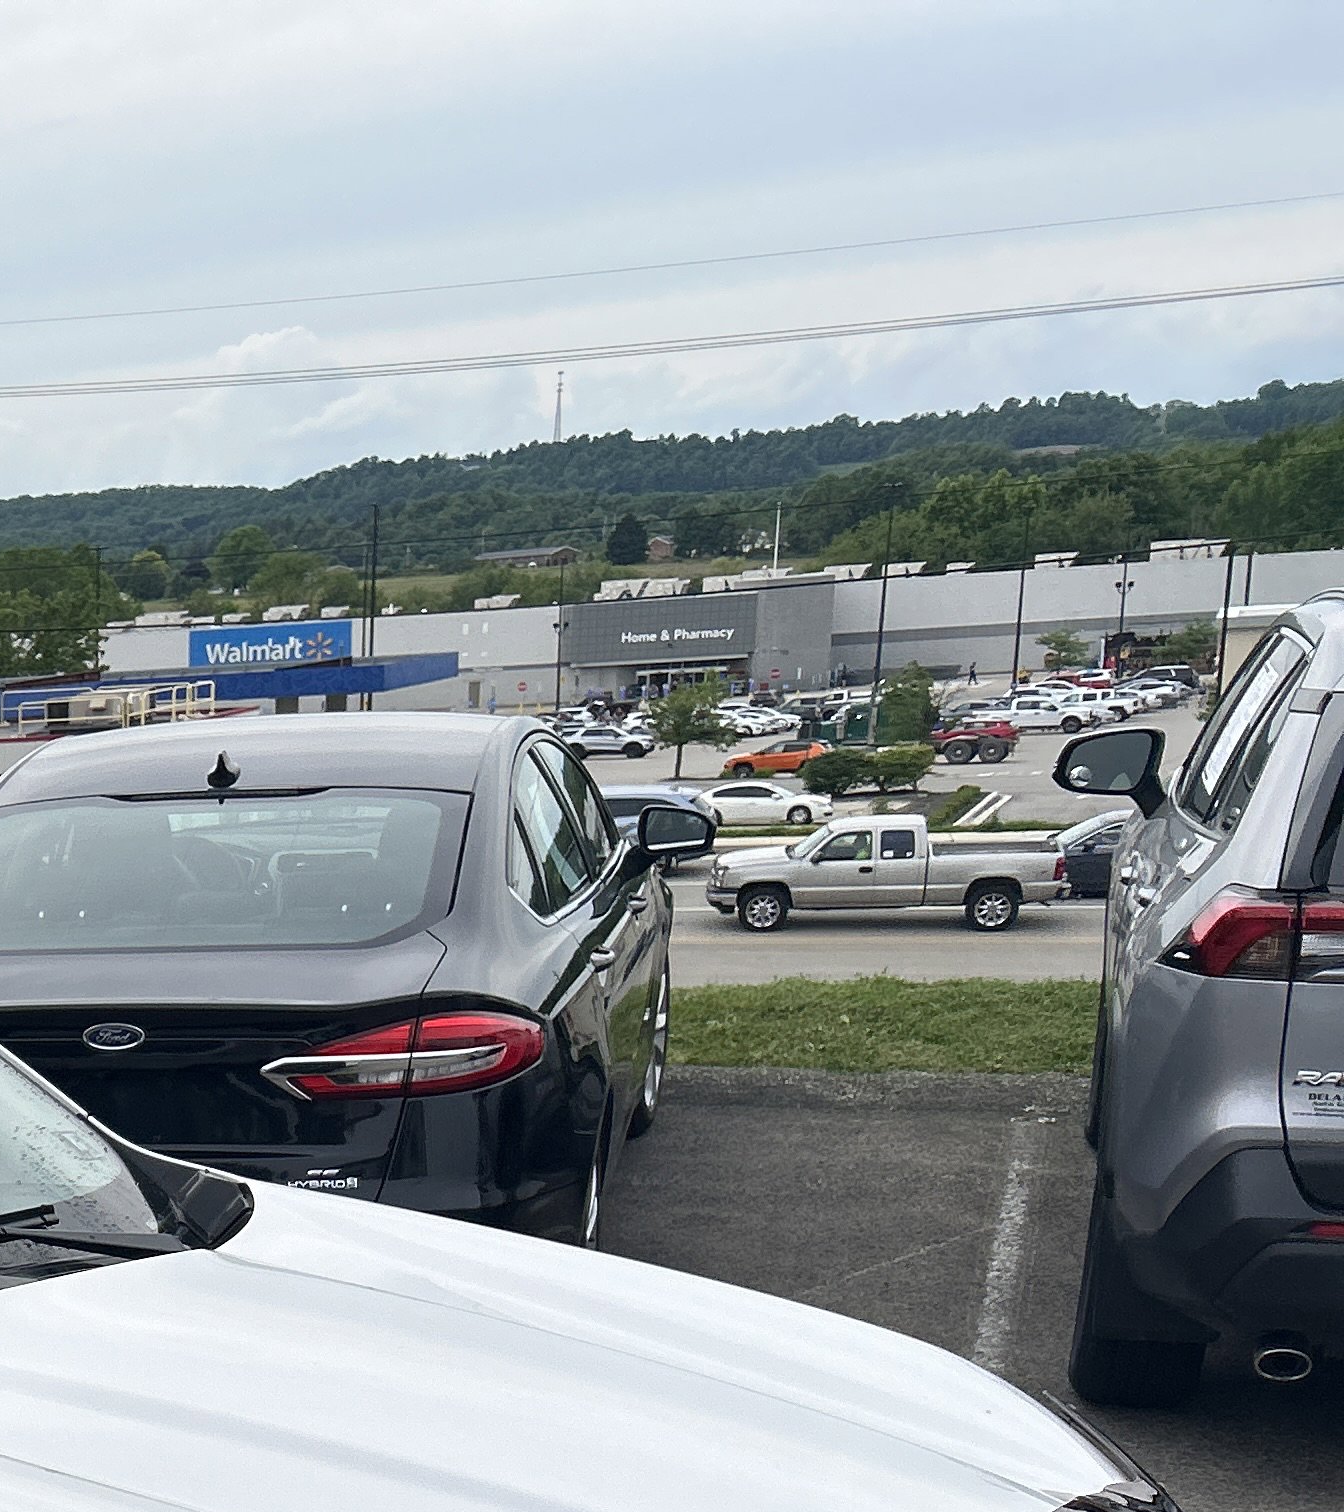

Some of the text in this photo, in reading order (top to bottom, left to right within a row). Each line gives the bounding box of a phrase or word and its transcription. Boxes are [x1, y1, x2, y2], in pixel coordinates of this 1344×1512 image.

[621, 627, 735, 643] Home & Pharmacy
[205, 636, 303, 664] Walmart
[96, 1027, 131, 1043] Ford
[1295, 1070, 1344, 1086] RA
[1308, 1093, 1344, 1101] DELA
[287, 1179, 345, 1188] HYBRID
